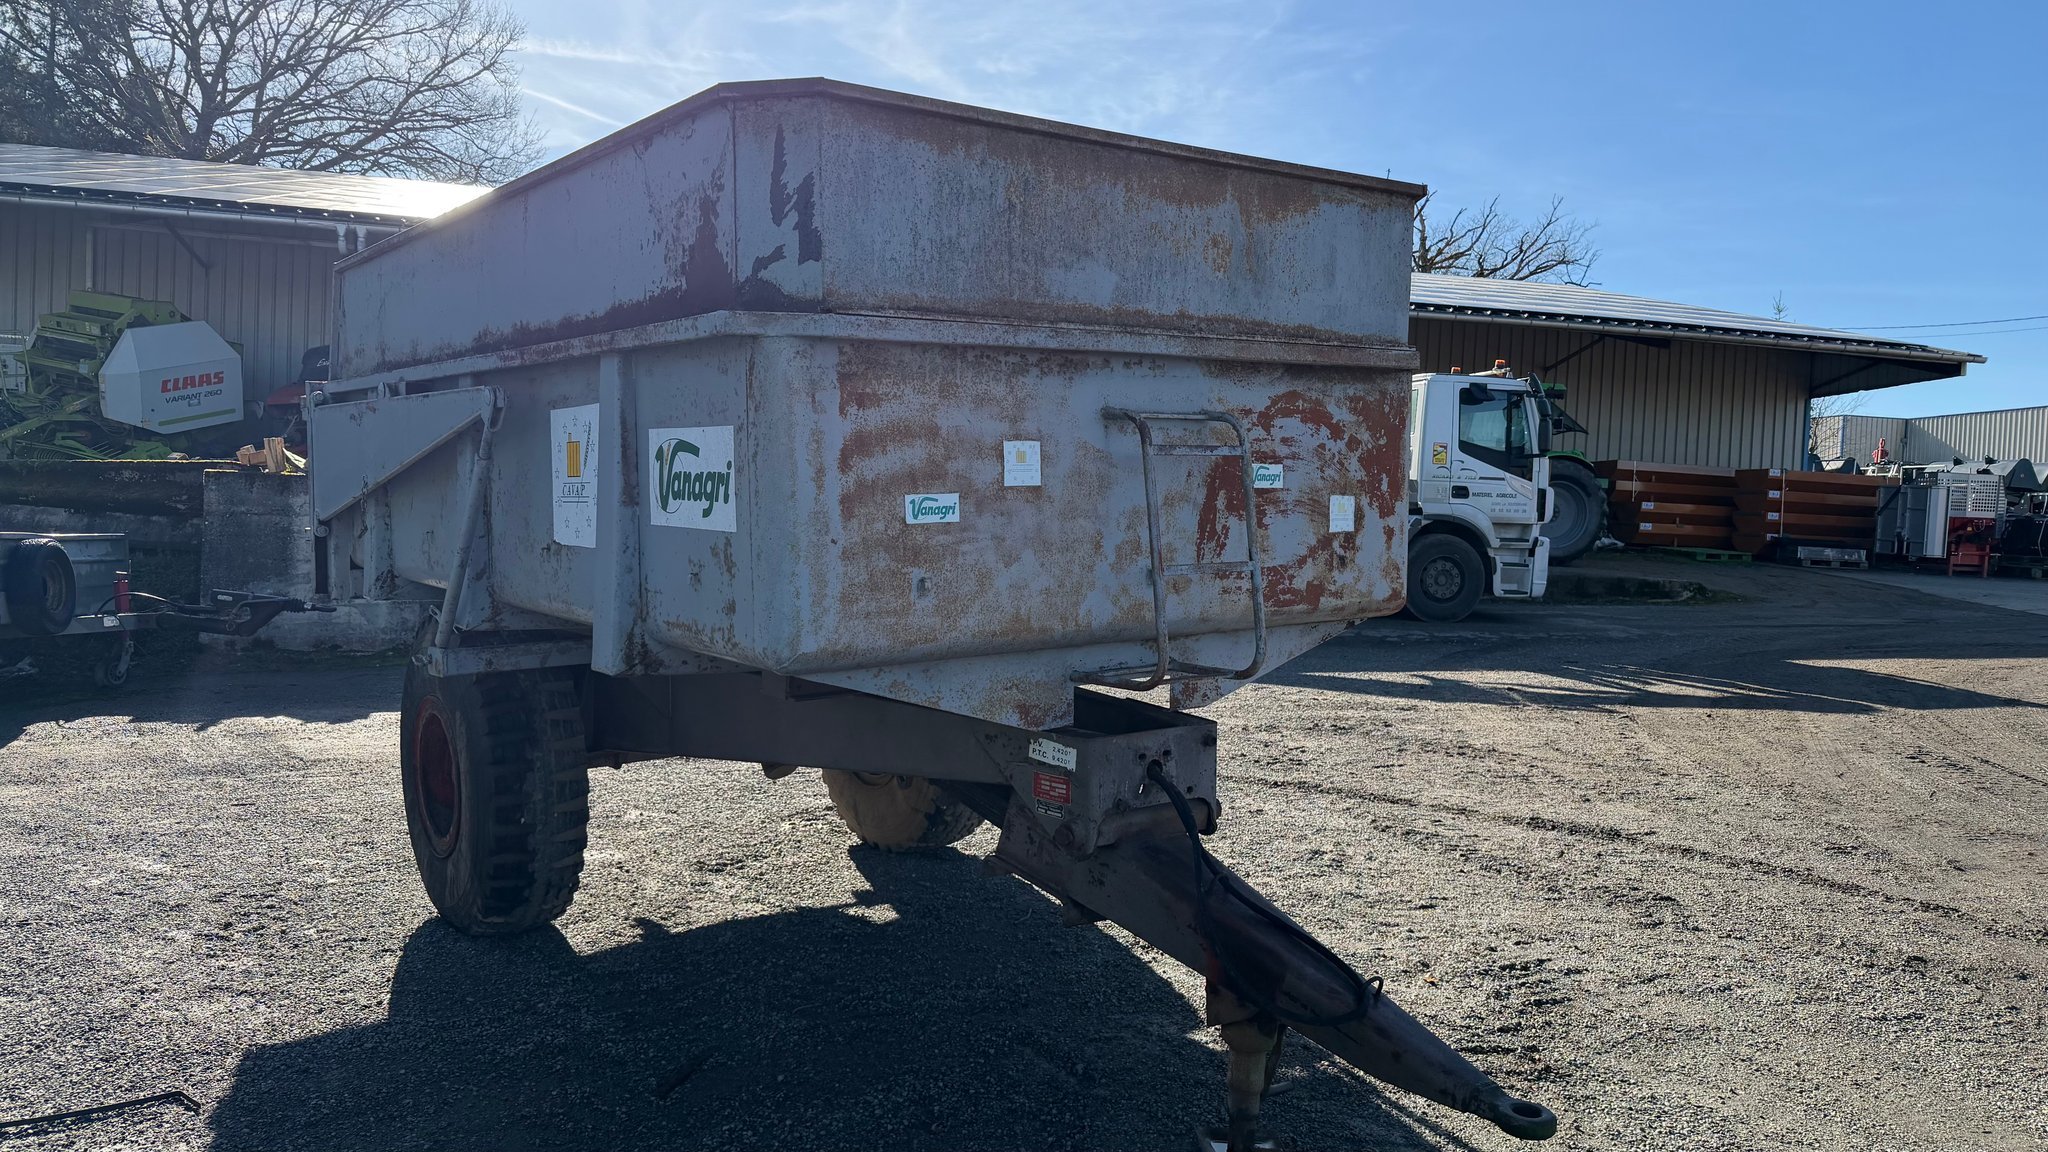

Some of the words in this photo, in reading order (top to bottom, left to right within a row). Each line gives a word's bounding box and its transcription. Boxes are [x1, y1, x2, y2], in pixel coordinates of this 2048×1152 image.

[161, 371, 224, 393] CLAAS
[165, 392, 203, 404] VARIANT
[204, 389, 223, 398] 260
[653, 438, 733, 518] Vanagri
[562, 484, 586, 496] CAVAP
[908, 496, 957, 520] Vanagri
[1032, 747, 1049, 759] P.T.C.
